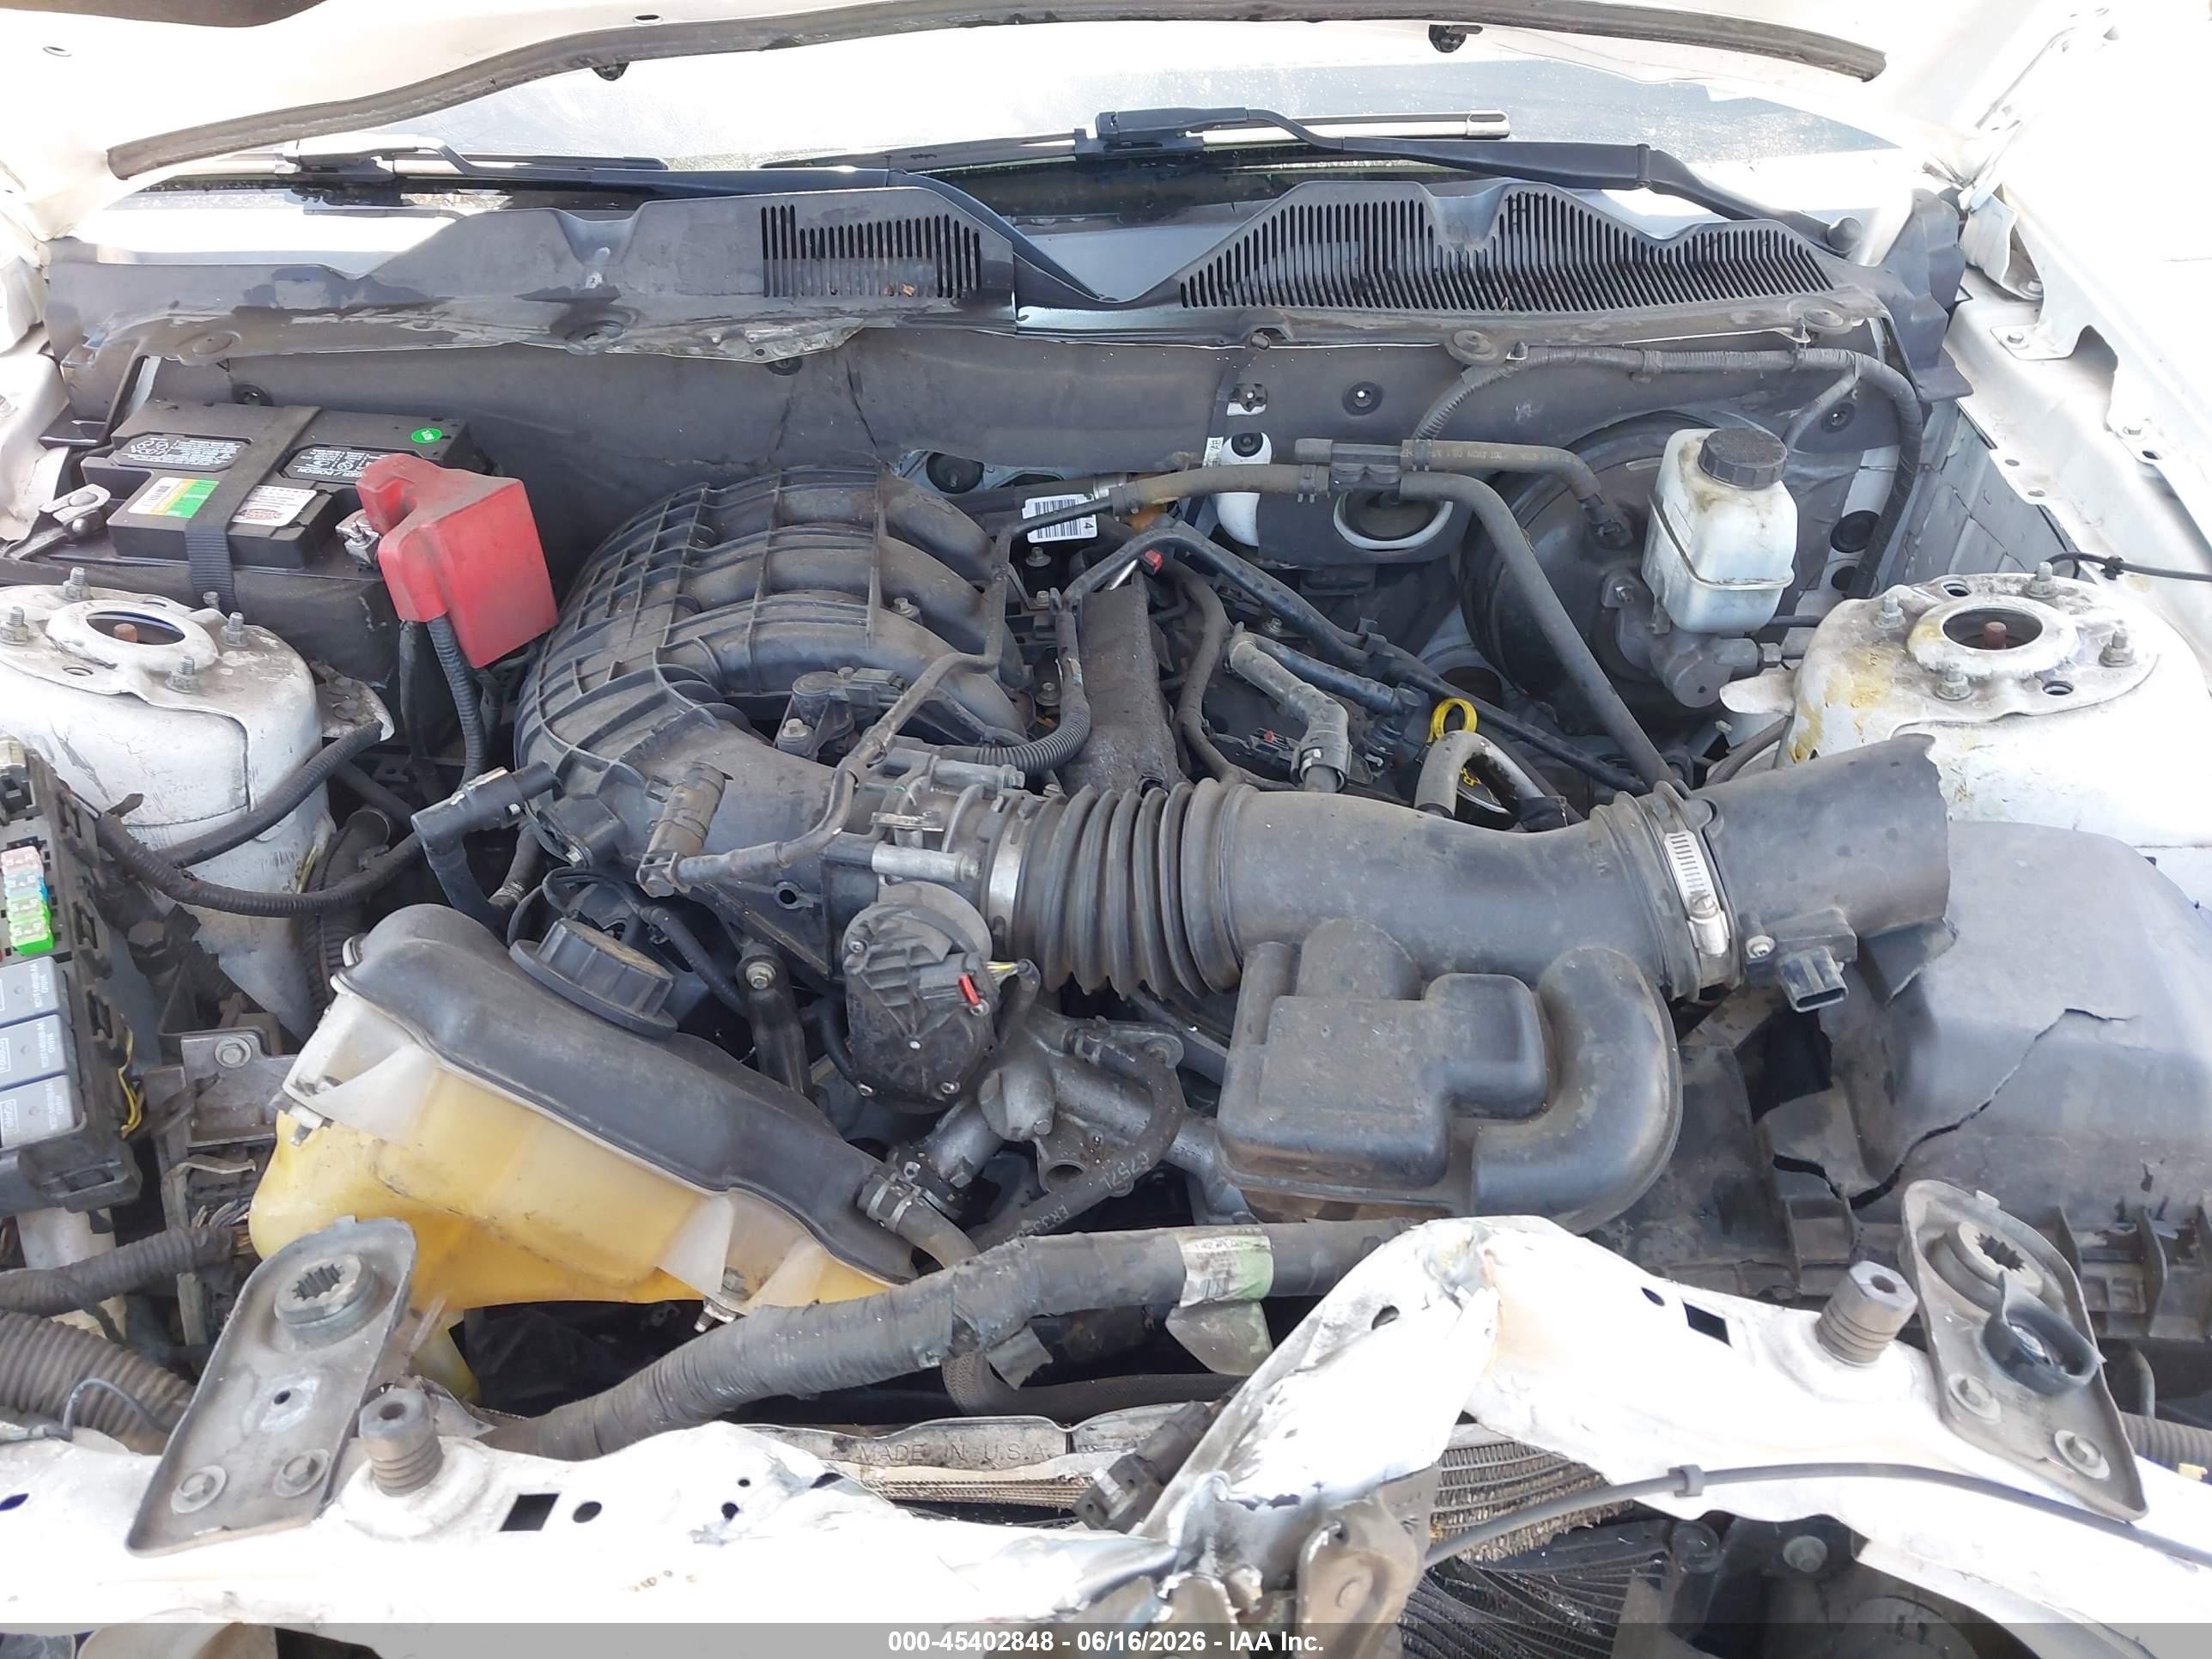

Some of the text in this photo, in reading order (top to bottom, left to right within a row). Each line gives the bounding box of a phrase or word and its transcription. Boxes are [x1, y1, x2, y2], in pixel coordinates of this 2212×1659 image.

[858, 1444, 924, 1463] MADE
[944, 1443, 968, 1462] IN
[982, 1441, 1054, 1462] U.S.A.
